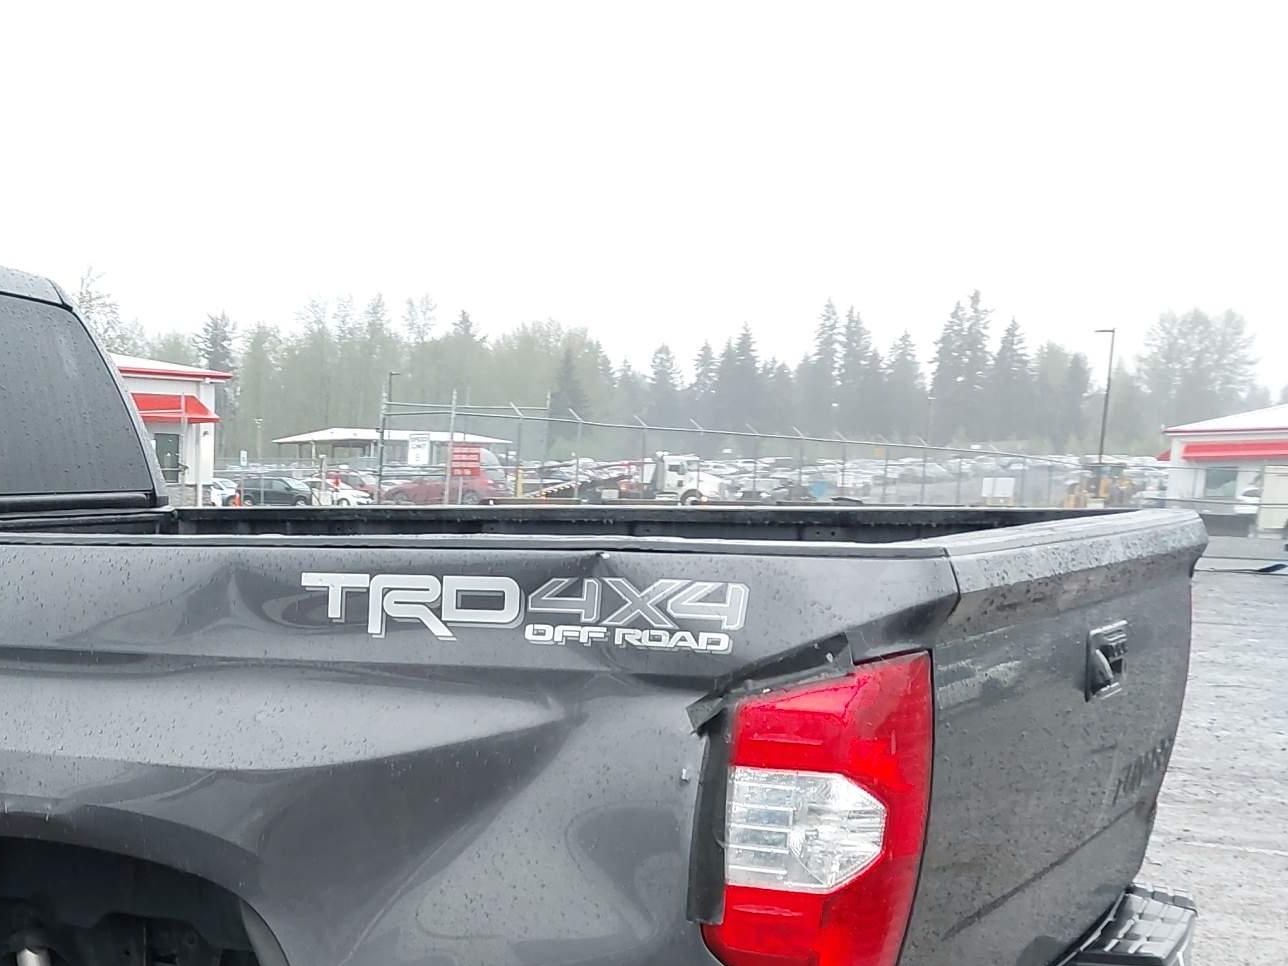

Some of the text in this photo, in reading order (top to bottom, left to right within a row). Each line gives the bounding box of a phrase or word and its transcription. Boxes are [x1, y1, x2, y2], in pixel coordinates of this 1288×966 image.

[300, 572, 524, 640] TRD
[524, 623, 733, 655] OFF ROAD
